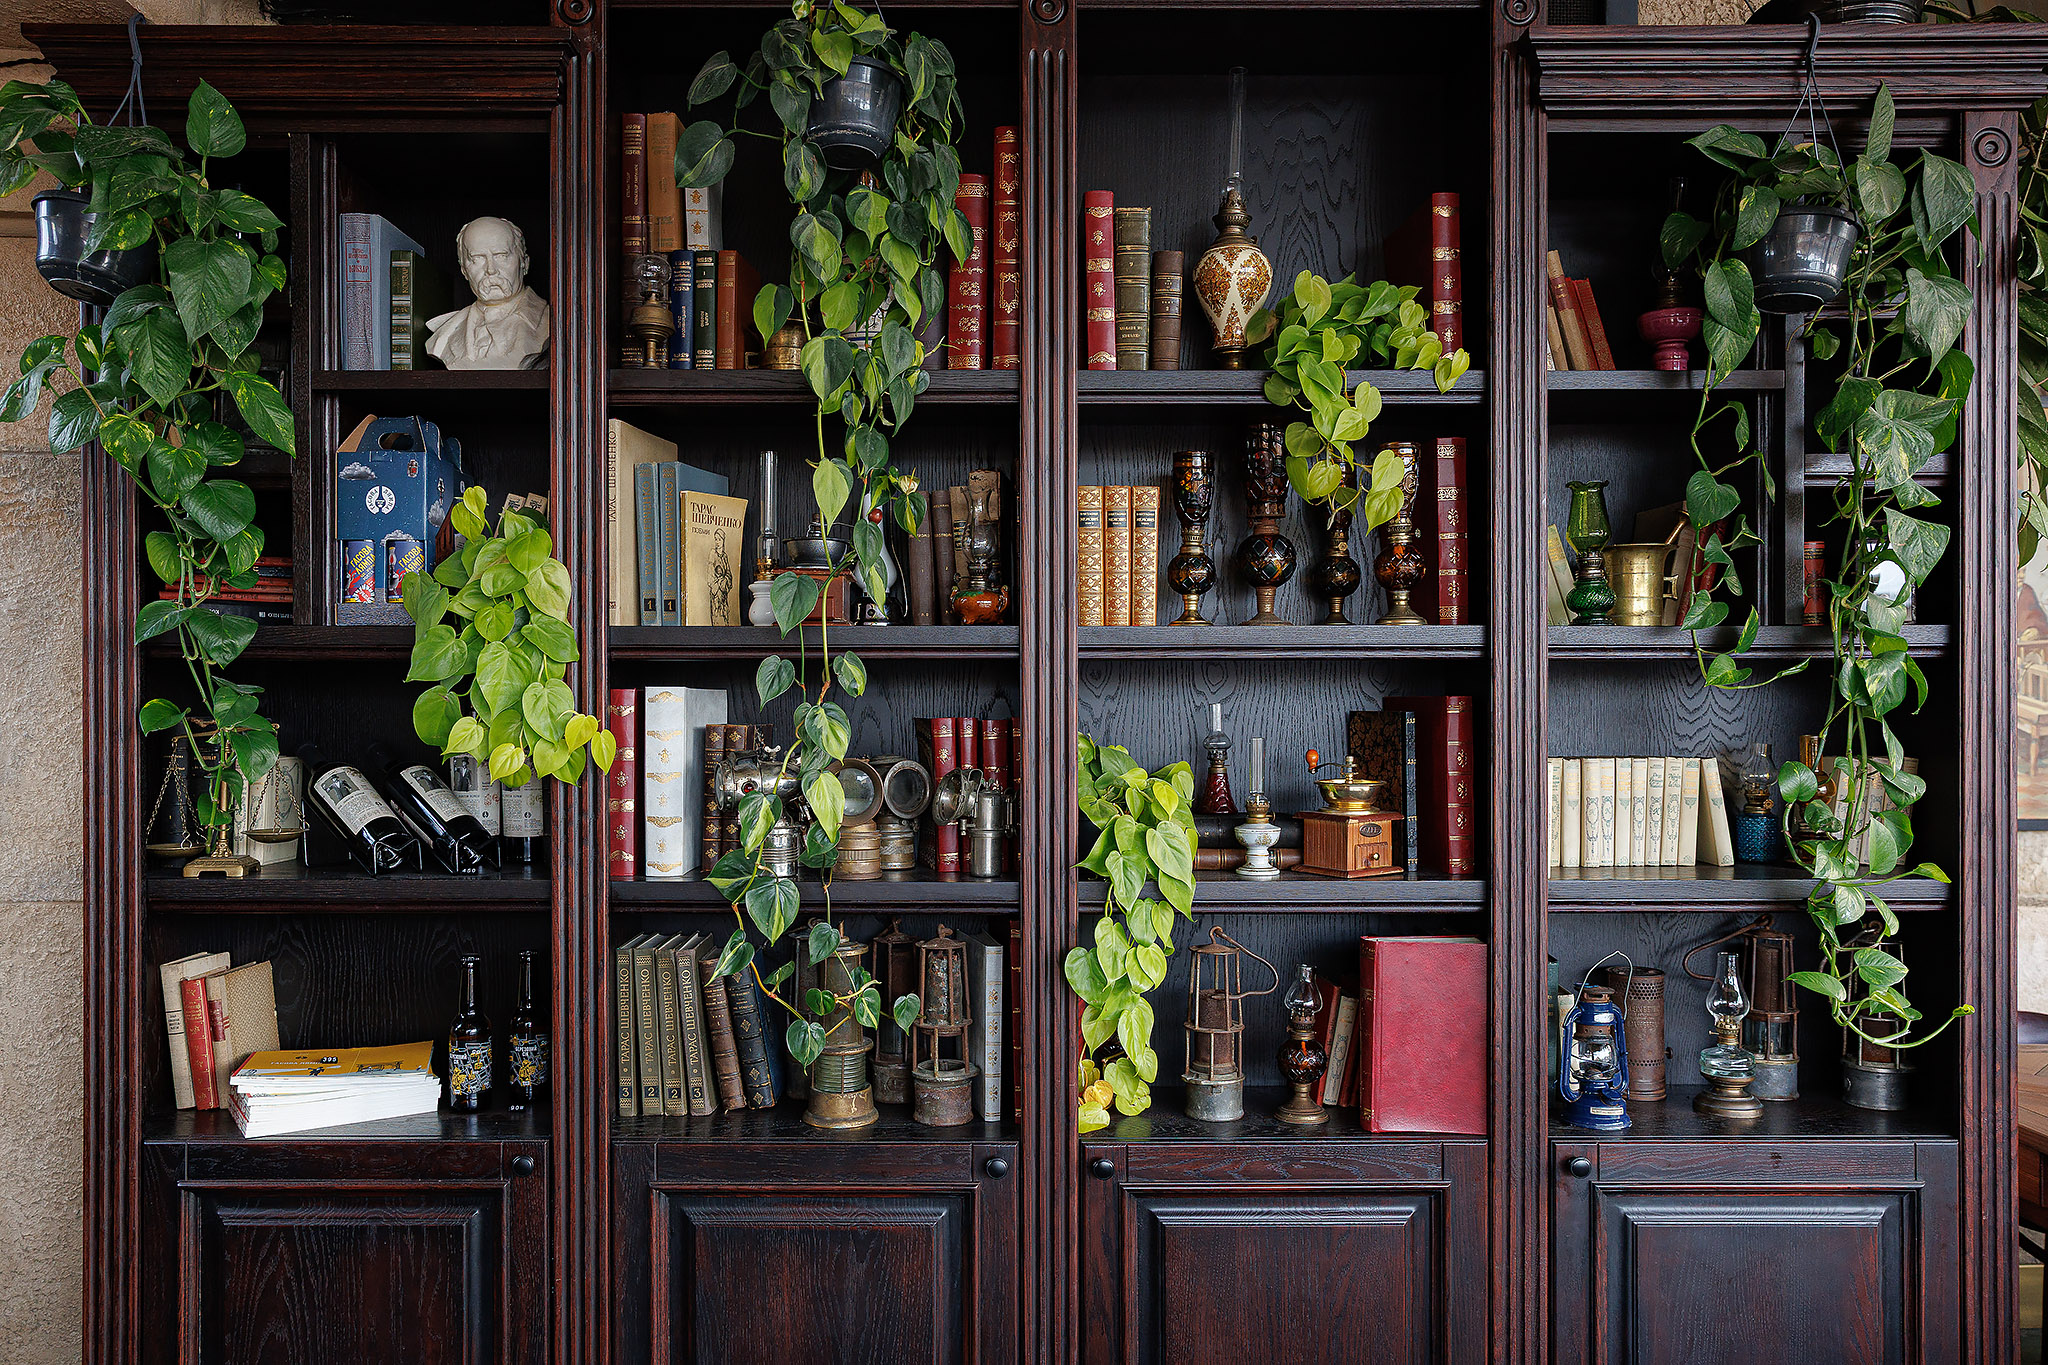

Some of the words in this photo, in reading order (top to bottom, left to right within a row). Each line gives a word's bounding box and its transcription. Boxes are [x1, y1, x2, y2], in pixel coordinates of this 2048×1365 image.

[608, 430, 617, 489] ШЕВЧЕНКО
[642, 480, 653, 542] ШЕВЧЕНКО
[665, 481, 675, 543] ШЕВЧЕНКО
[690, 501, 717, 515] ТАРАС
[692, 512, 742, 529] ШЕВЧЕНКО
[691, 526, 711, 536] ПОЕМИ
[350, 545, 374, 568] ГАСОВА
[354, 553, 376, 575] ЛЯМПА
[398, 545, 424, 568] ГАСОВА
[644, 545, 653, 576] ТАРАС
[666, 546, 675, 578] ТАРАС
[668, 600, 672, 611] 1
[619, 968, 630, 1029] ШЕВЧЕНКО
[640, 968, 652, 1030] ШЕВЧЕНКО
[662, 971, 675, 1031] ШЕВЧЕНКО
[682, 970, 696, 1030] ШЕВЧЕНКО
[621, 1032, 630, 1064] ТАРАС
[644, 1032, 653, 1064] ТАРАС
[667, 1035, 677, 1067] ТАРАС
[688, 1032, 699, 1066] ТАРАС
[622, 1088, 630, 1097] 3
[648, 1087, 655, 1096] 2
[671, 1089, 678, 1098] 2
[694, 1088, 701, 1097] 3
